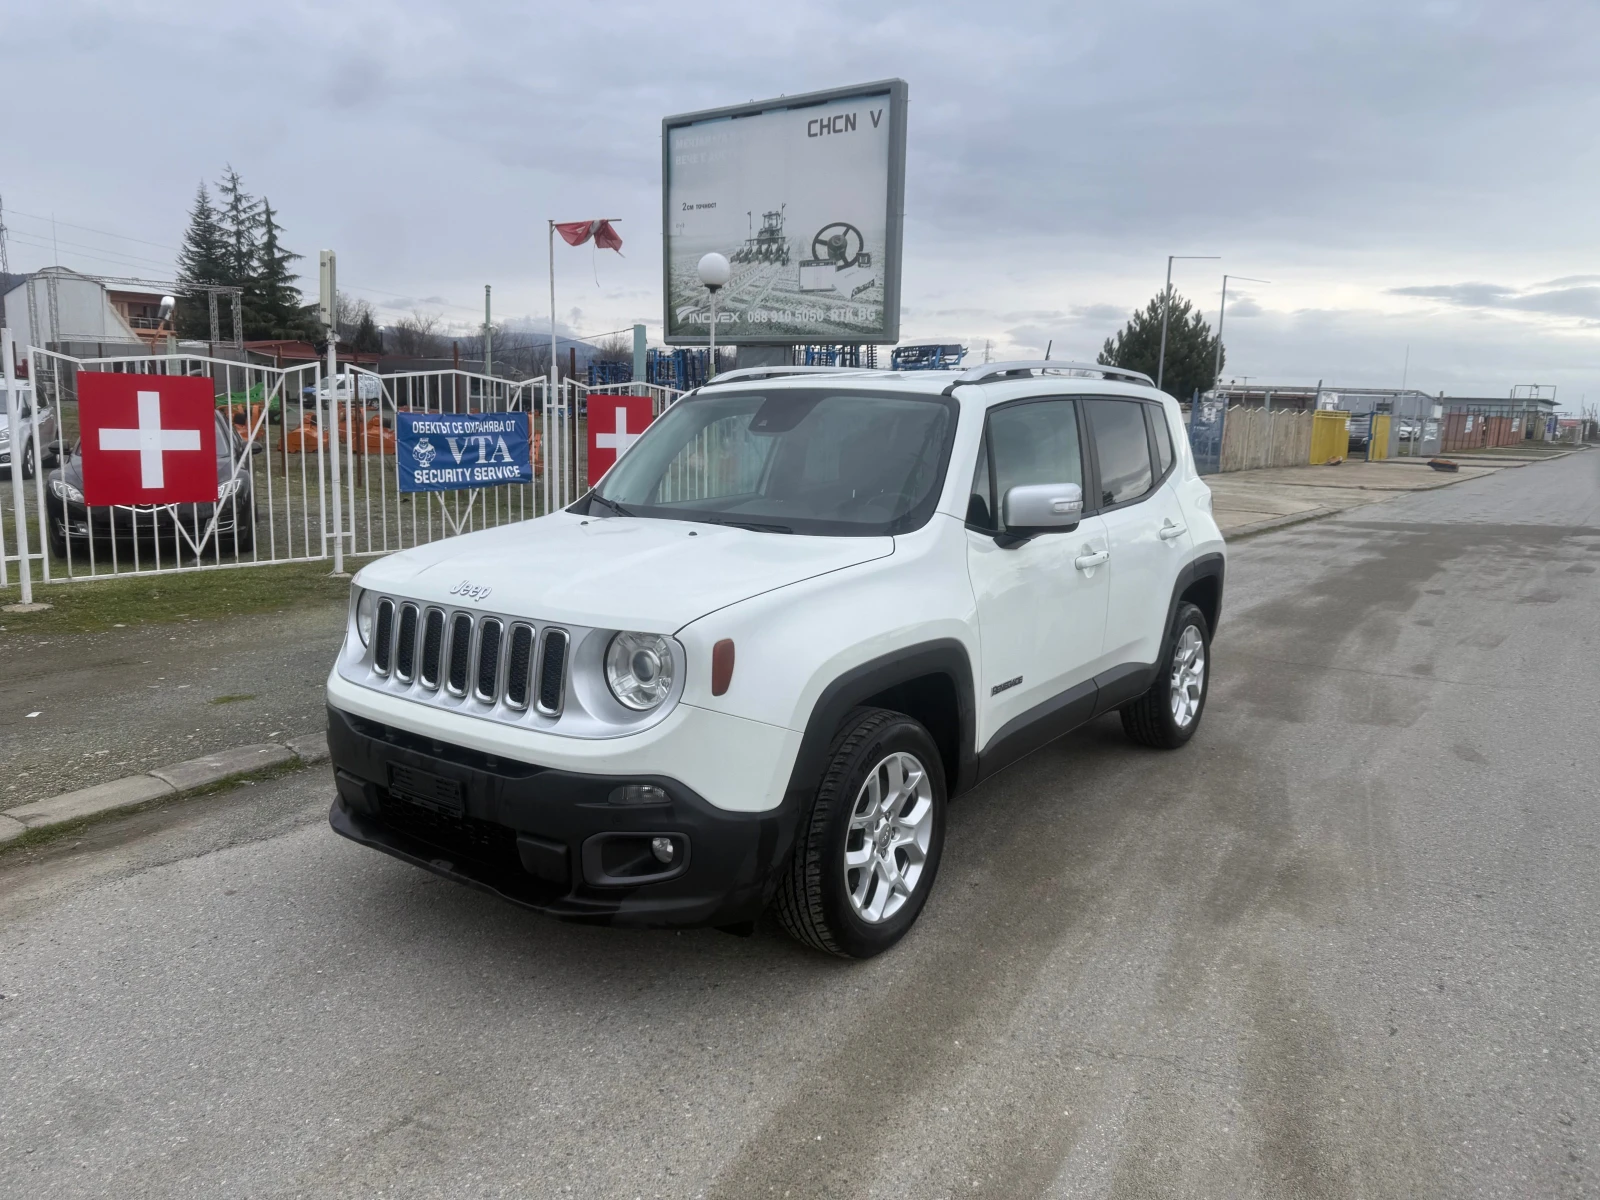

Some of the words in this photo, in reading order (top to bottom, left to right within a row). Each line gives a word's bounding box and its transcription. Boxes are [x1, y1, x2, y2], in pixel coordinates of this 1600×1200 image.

[807, 112, 857, 138] CHCN
[869, 108, 883, 129] V
[747, 310, 768, 323] 088
[770, 310, 792, 323] 910
[795, 309, 824, 322] 5050
[412, 421, 451, 434] ОБЕКТЪТ
[451, 421, 464, 433] СЕ
[464, 421, 504, 433] ОХРАНЯВА
[506, 420, 516, 432] ОТ
[445, 434, 514, 465] VTA
[414, 468, 471, 484] SECURITY
[474, 465, 520, 481] SERVICE
[450, 580, 492, 602] Jeep
